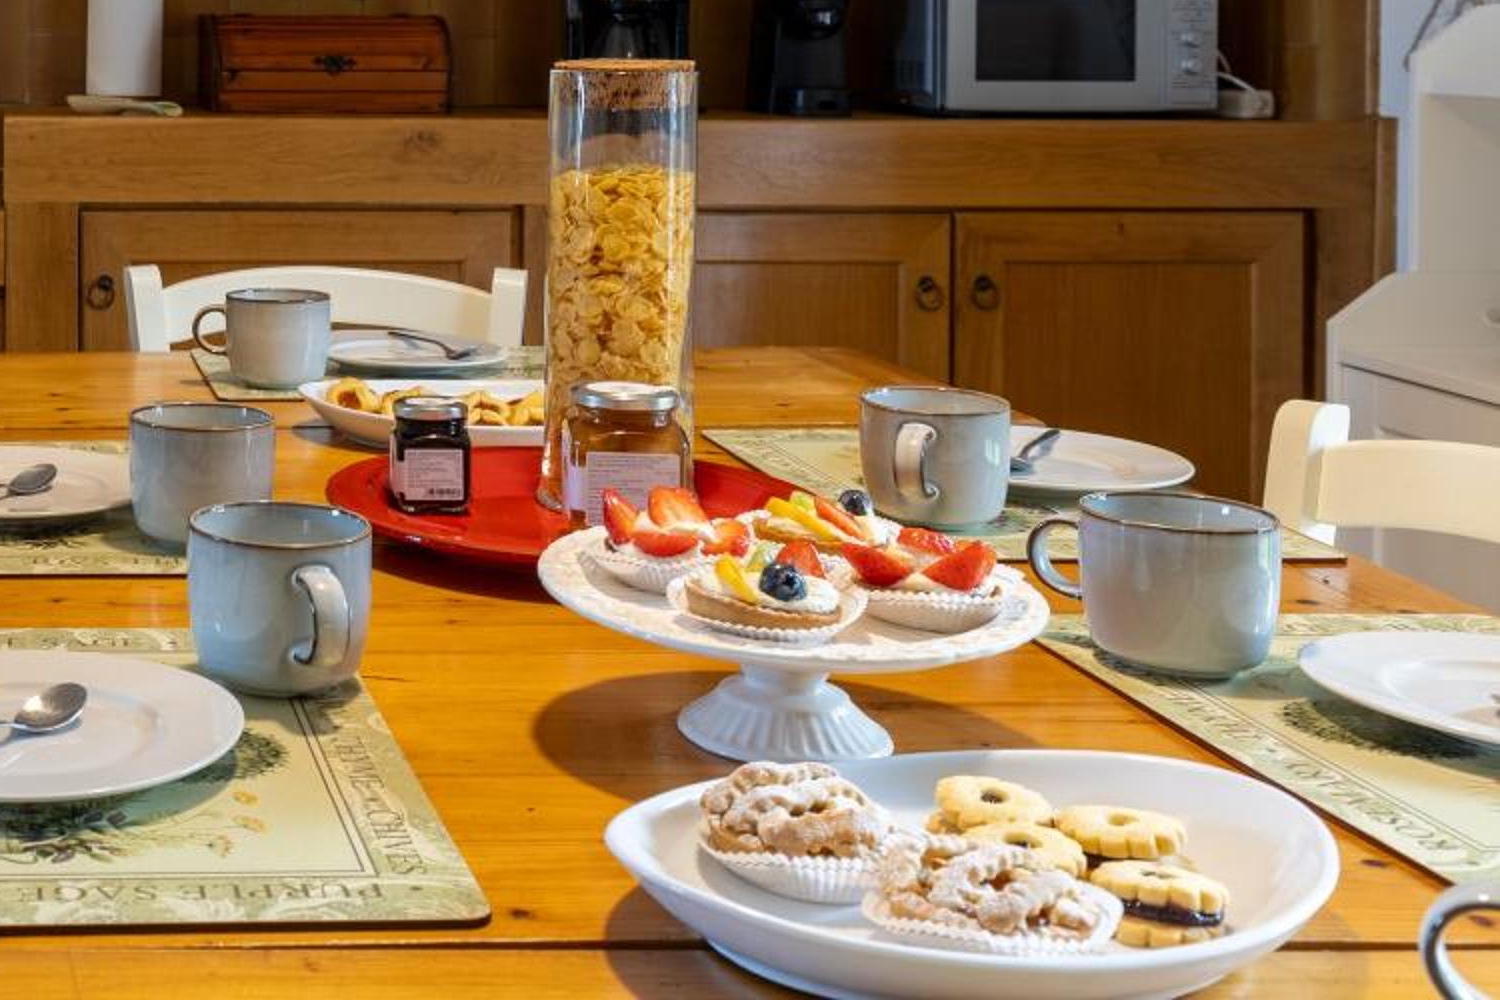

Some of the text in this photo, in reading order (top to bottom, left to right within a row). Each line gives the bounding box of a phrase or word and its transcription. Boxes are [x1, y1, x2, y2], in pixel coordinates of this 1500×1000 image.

[366, 810, 429, 876] CHIVES
[18, 884, 157, 903] SAGE
[179, 882, 384, 901] PURPLE
